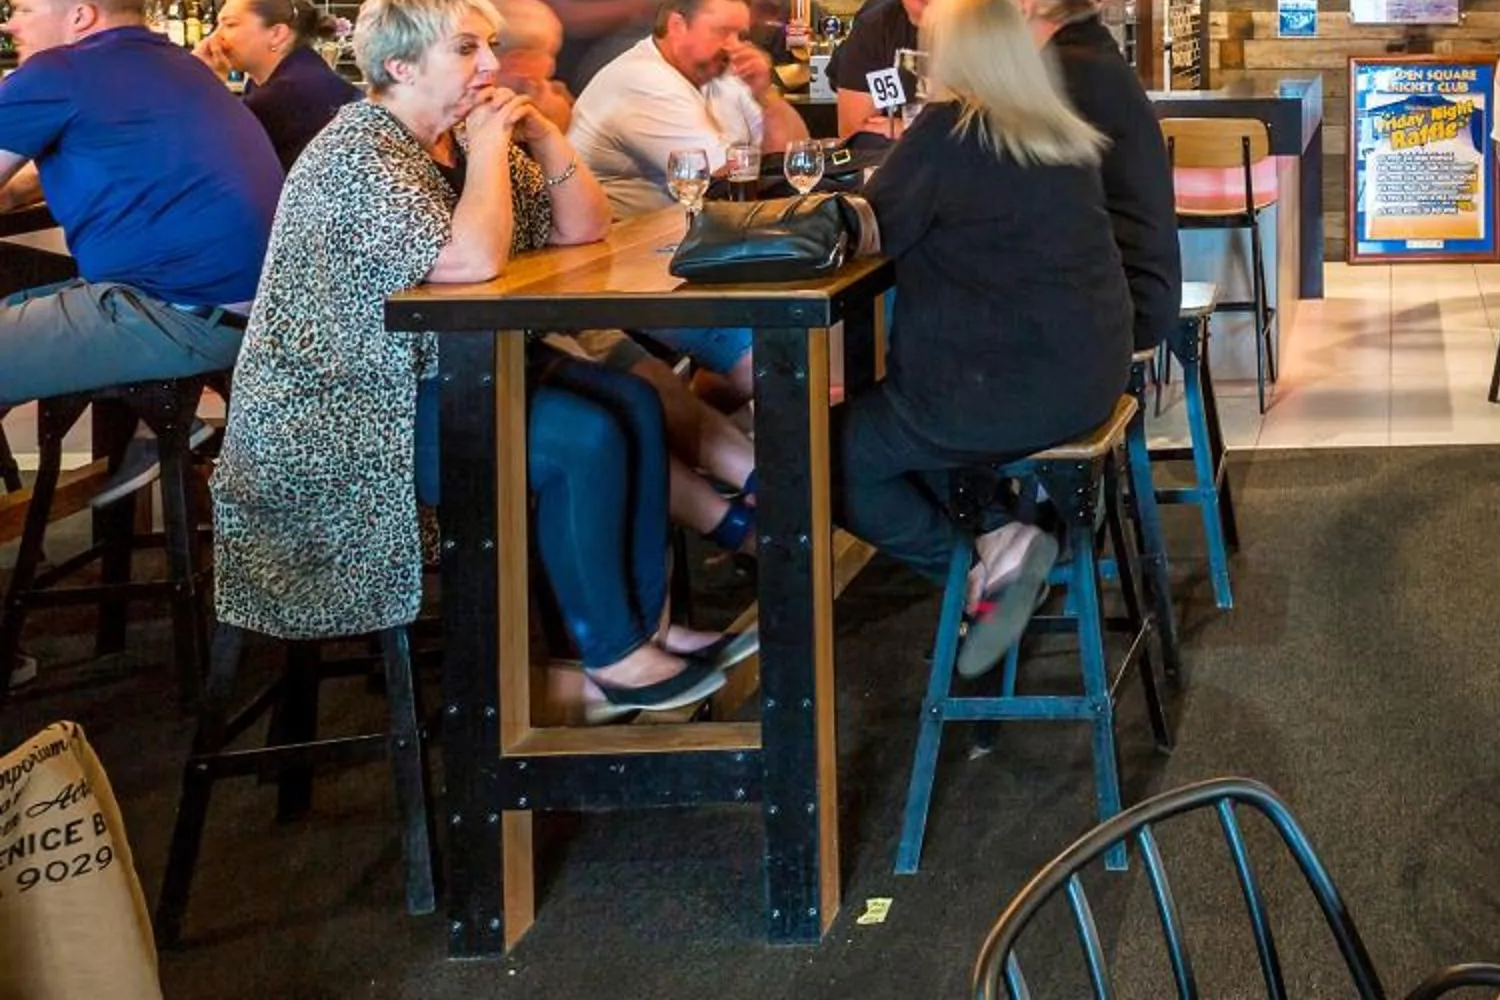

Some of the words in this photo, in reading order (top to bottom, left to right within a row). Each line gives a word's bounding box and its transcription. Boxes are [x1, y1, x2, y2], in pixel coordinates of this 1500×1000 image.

[873, 75, 899, 101] 95
[1427, 69, 1477, 81] SQUARE
[1437, 81, 1469, 92] CLUB
[1375, 112, 1425, 132] Friday
[1431, 97, 1474, 122] Night
[1390, 120, 1457, 149] Raffle
[16, 846, 113, 892] 9029
